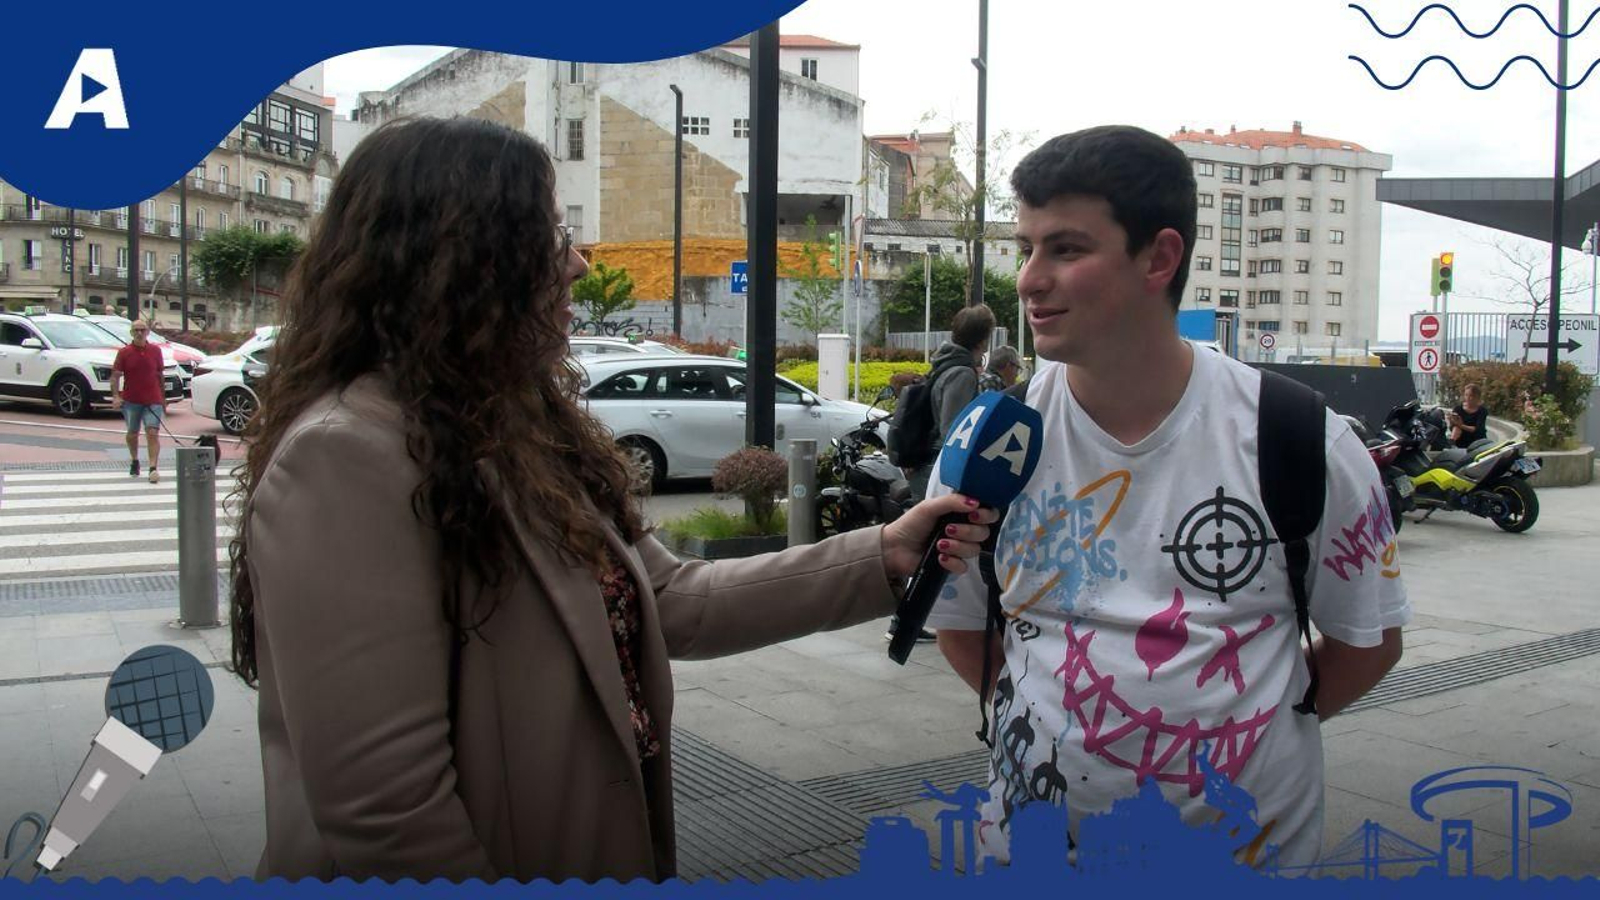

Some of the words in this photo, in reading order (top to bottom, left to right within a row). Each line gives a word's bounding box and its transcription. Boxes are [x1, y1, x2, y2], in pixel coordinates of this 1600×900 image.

[51, 227, 85, 237] HOEL
[733, 273, 748, 283] TA
[1510, 319, 1550, 331] ACCES
[1558, 319, 1597, 331] PEONIL
